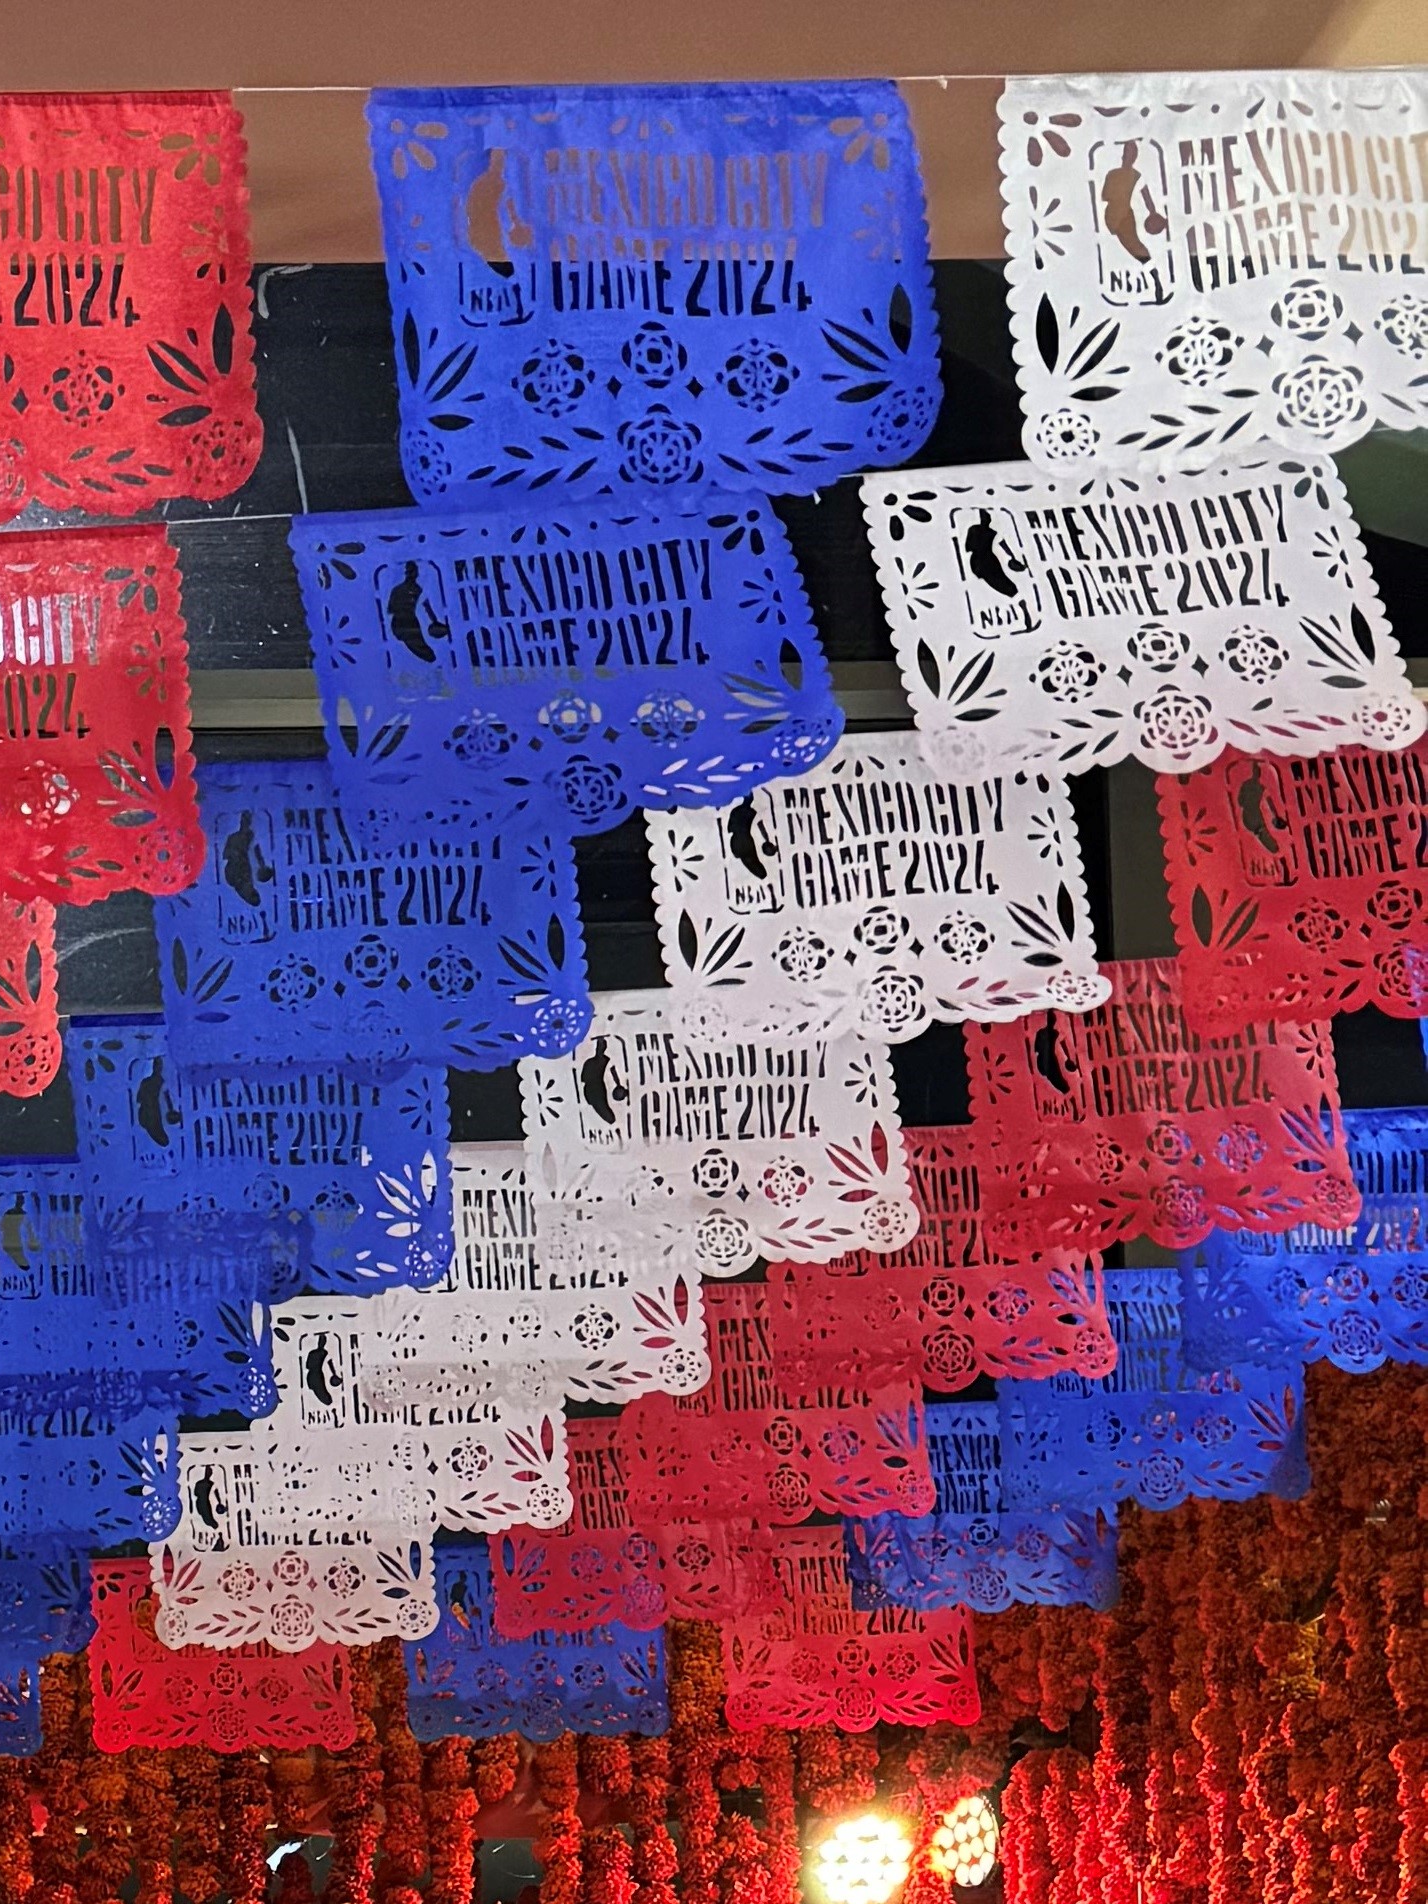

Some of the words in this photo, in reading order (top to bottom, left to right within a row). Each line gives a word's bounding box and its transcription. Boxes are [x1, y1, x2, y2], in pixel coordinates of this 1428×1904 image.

[54, 165, 159, 247] CITY
[549, 149, 716, 230] MEXICO
[723, 150, 828, 231] CITY
[1180, 124, 1353, 217] MEXICO
[1366, 128, 1428, 206] CIT
[550, 237, 675, 314] GAME
[682, 238, 814, 318] 2024
[1186, 204, 1319, 291] GAME
[1328, 202, 1427, 275] 202
[11, 251, 143, 329] 2024
[1024, 500, 1185, 562] MEXICO
[1189, 484, 1291, 552] CITY
[453, 546, 616, 623] MEXICO
[619, 537, 711, 611] CITY
[1044, 562, 1163, 622] GAME
[1165, 547, 1291, 617] 2024
[12, 592, 103, 667] CITY
[464, 614, 578, 682] GAME
[585, 599, 711, 676] 2024
[783, 780, 921, 845] MEXICO
[924, 776, 1004, 837] CITY
[1307, 813, 1412, 878] GAME
[288, 866, 386, 935] GAME
[397, 866, 494, 927] 2024
[790, 844, 897, 909] GAME
[899, 839, 1000, 896] 2024
[639, 1084, 728, 1143] GAME
[736, 1083, 821, 1141] 2024
[1091, 1060, 1182, 1120] GAME
[1182, 1050, 1277, 1113] 2024
[193, 1112, 279, 1161] GAME
[286, 1110, 374, 1168] 2024
[465, 1244, 542, 1292] GAME
